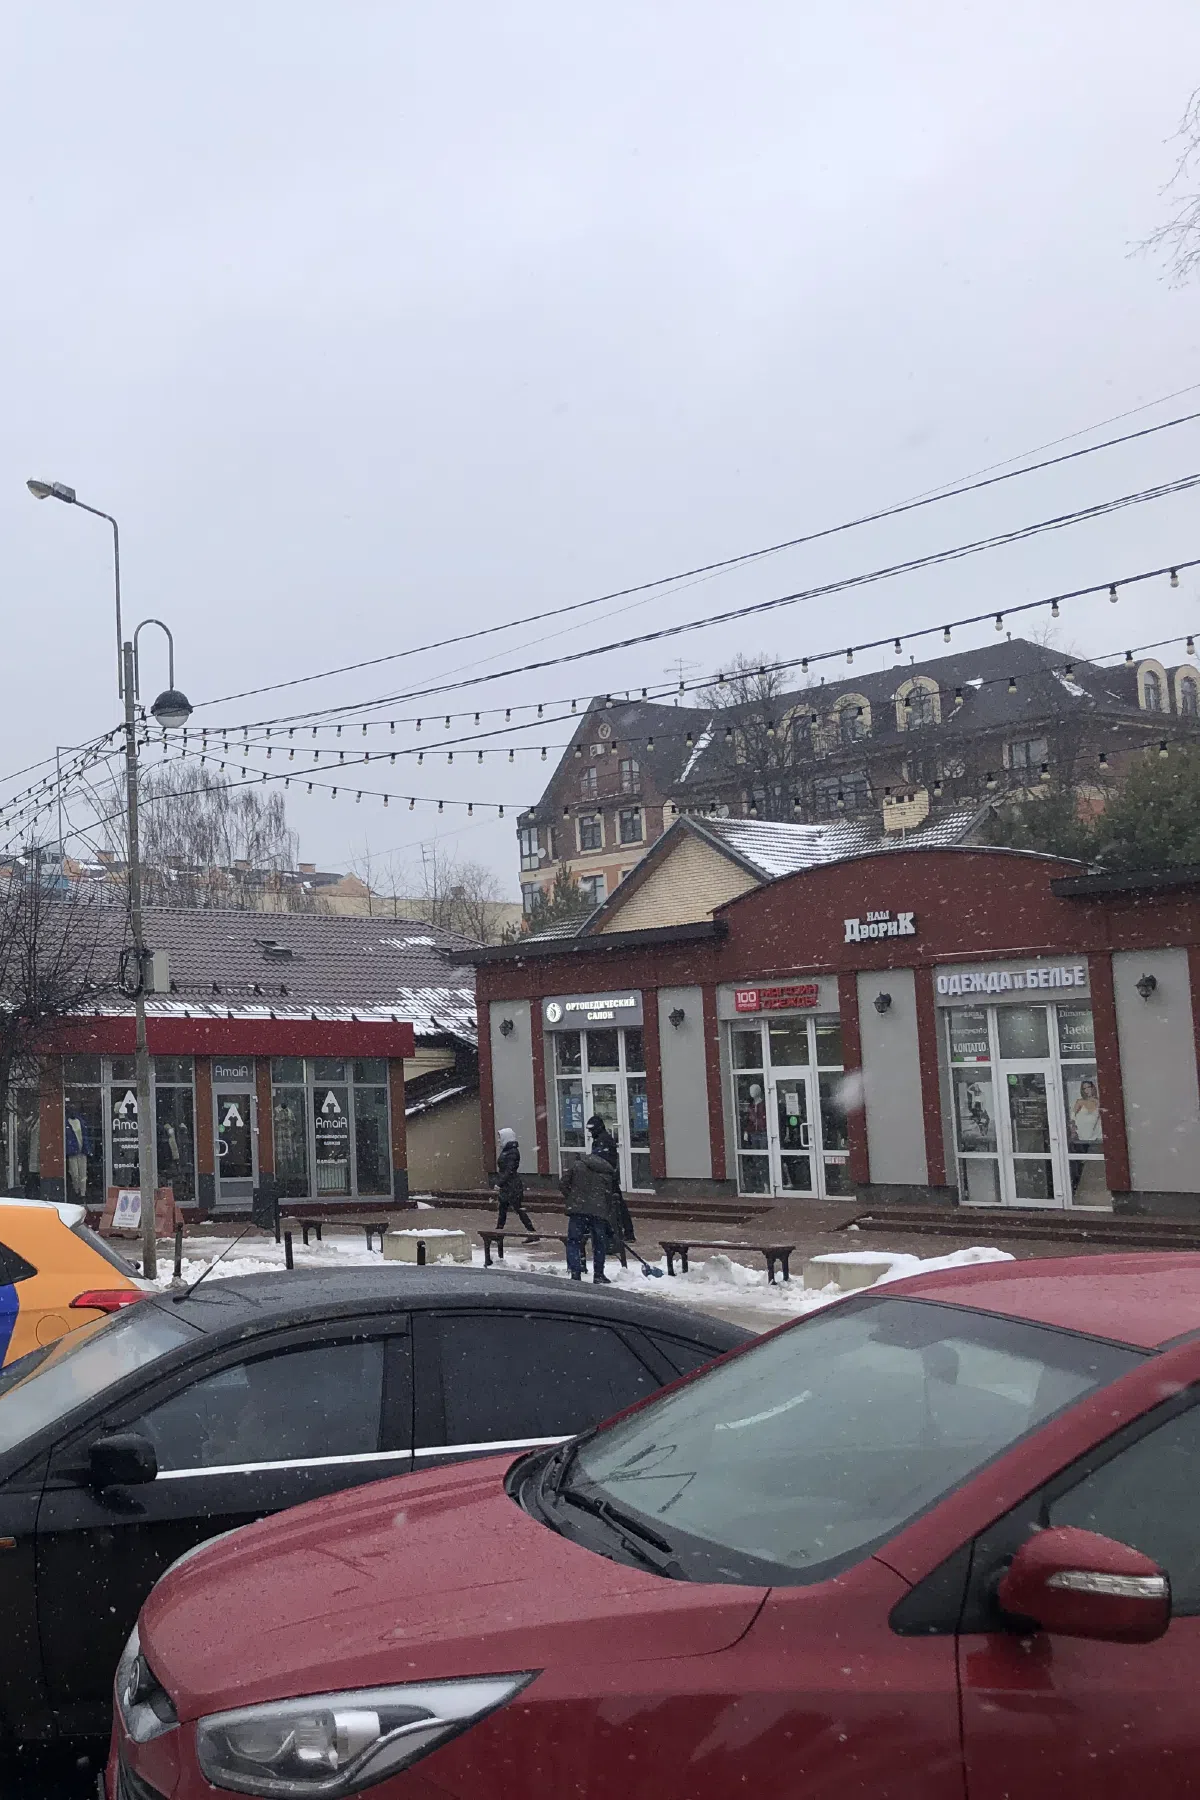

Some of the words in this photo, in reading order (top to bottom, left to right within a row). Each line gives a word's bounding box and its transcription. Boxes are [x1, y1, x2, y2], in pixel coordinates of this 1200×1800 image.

[866, 910, 890, 922] НАШ
[937, 971, 1013, 996] ОДЕЖДА
[1026, 965, 1086, 988] БЕЛЬЕ
[736, 991, 757, 1003] 100
[565, 996, 636, 1011] ОРТОПЕДИЧЕСКИЙ
[587, 1011, 614, 1021] САЛОН
[215, 1065, 249, 1077] AmaiA
[112, 1118, 138, 1131] Ama
[315, 1117, 348, 1129] AmaiA
